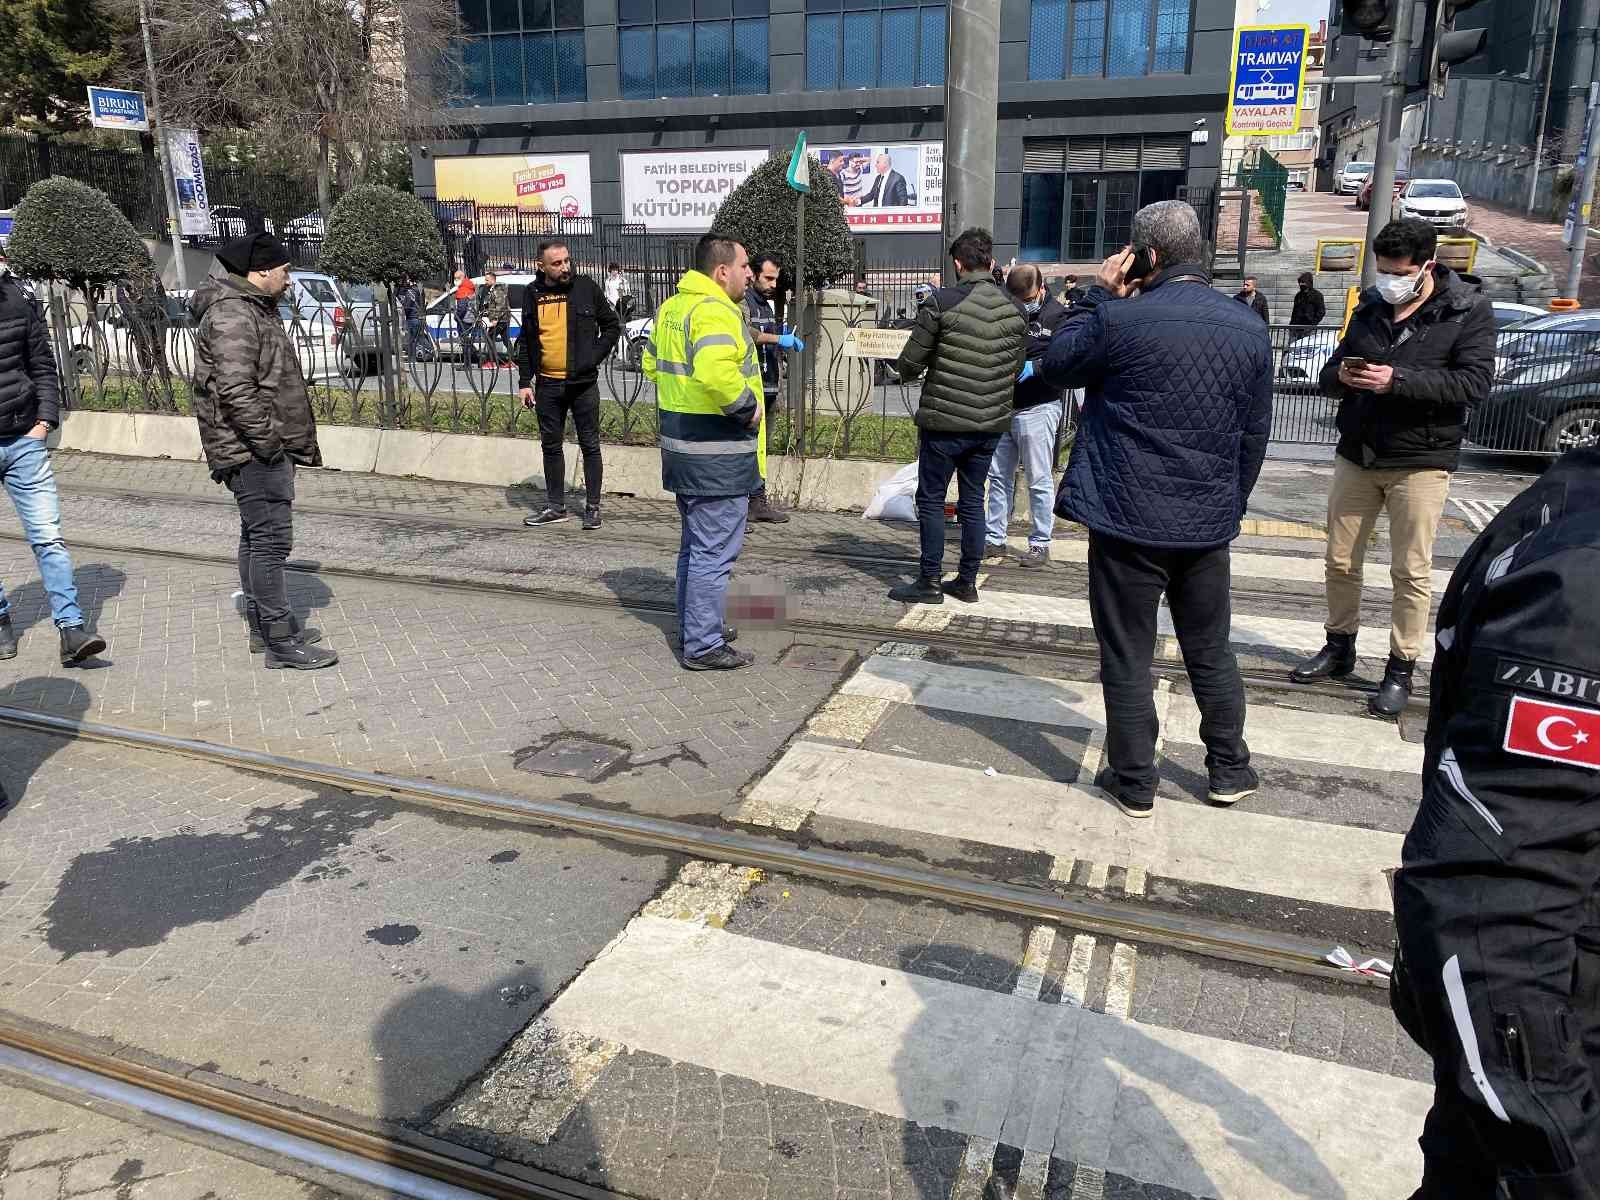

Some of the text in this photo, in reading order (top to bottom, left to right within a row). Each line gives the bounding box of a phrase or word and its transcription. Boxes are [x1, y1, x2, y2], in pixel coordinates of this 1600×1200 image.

[1239, 51, 1301, 66] TRAMVAY
[1234, 107, 1287, 117] YAYALAR
[644, 160, 747, 175] FATİH BELEDİYESİ
[925, 164, 940, 177] bizi
[655, 178, 735, 194] TOPKAPI
